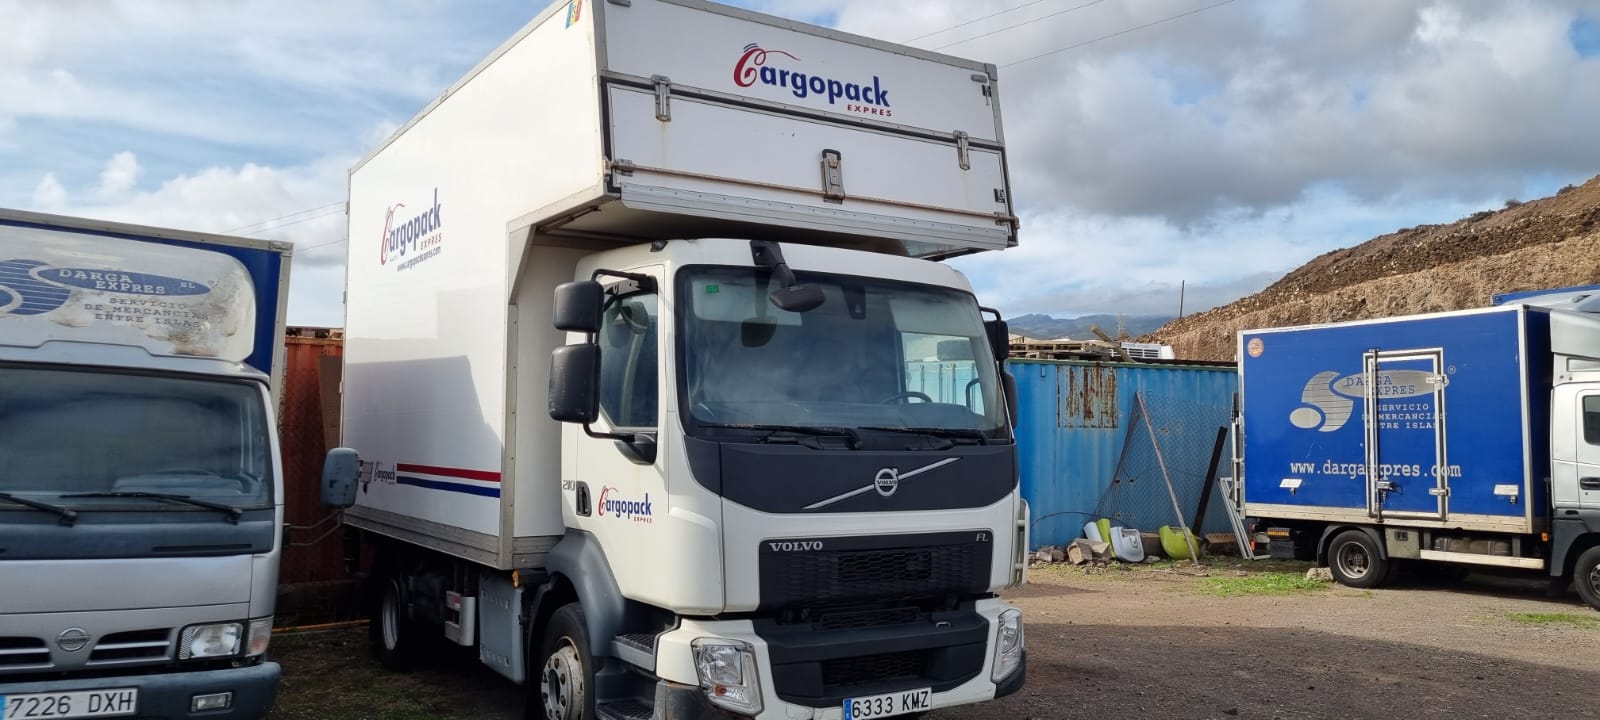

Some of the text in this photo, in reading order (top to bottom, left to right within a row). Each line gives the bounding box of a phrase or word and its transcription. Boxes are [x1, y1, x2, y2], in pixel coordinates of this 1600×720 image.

[734, 46, 890, 107] Cargopack
[847, 104, 892, 117] EXPRES
[381, 187, 441, 265] Cargopack
[59, 269, 133, 284] DARGA
[95, 280, 166, 295] EXPRES
[84, 303, 104, 312] DE
[109, 297, 187, 309] SERVICIO
[95, 313, 144, 323] ENTRE
[598, 487, 652, 520] Cargopack
[976, 533, 989, 542] FL
[768, 541, 823, 552] VOLVO
[9, 691, 133, 718] 7226 DXH
[852, 691, 929, 718] 6333 KMZ
